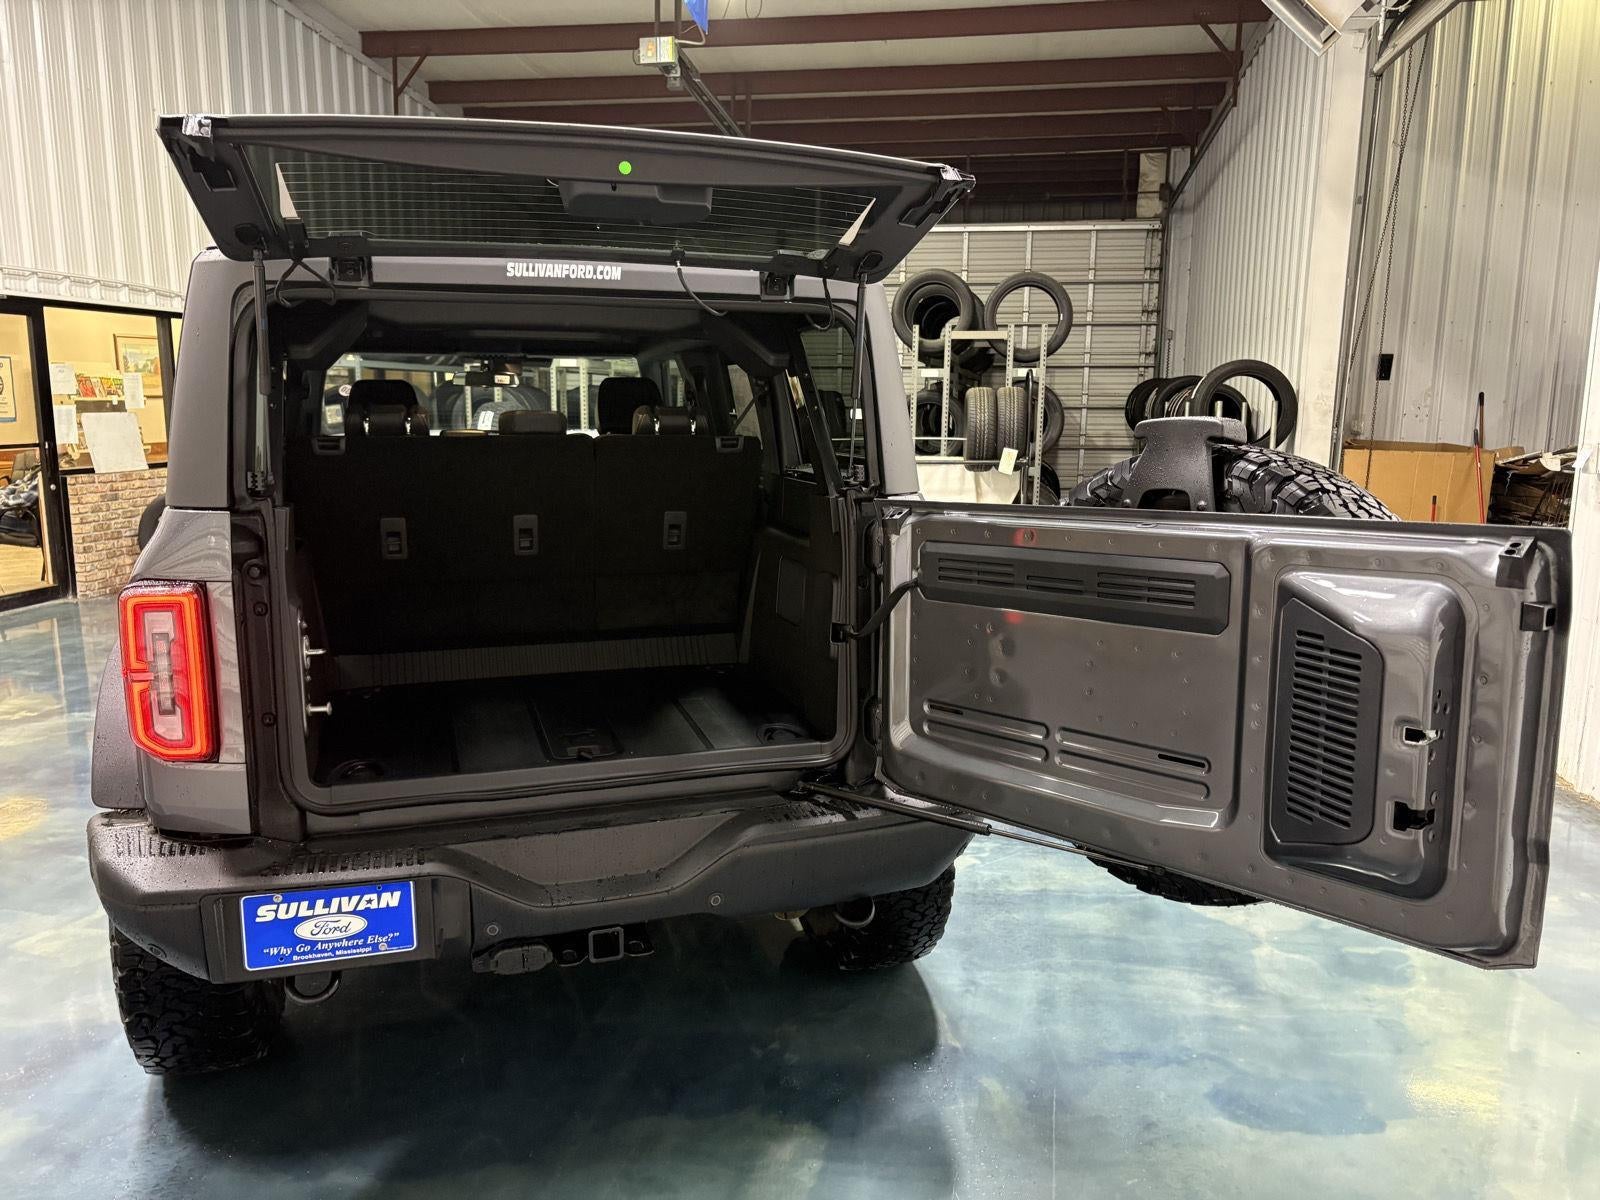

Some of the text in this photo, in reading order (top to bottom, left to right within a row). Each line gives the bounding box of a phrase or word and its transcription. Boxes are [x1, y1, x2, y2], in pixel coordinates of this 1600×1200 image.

[507, 262, 622, 280] SULLIVANFORD.COM
[255, 891, 401, 922] SULLIVAN
[311, 919, 352, 936] Ford
[293, 946, 372, 961] Brookhaven, Mississippi
[296, 943, 311, 953] Go
[314, 938, 364, 951] Anywhere
